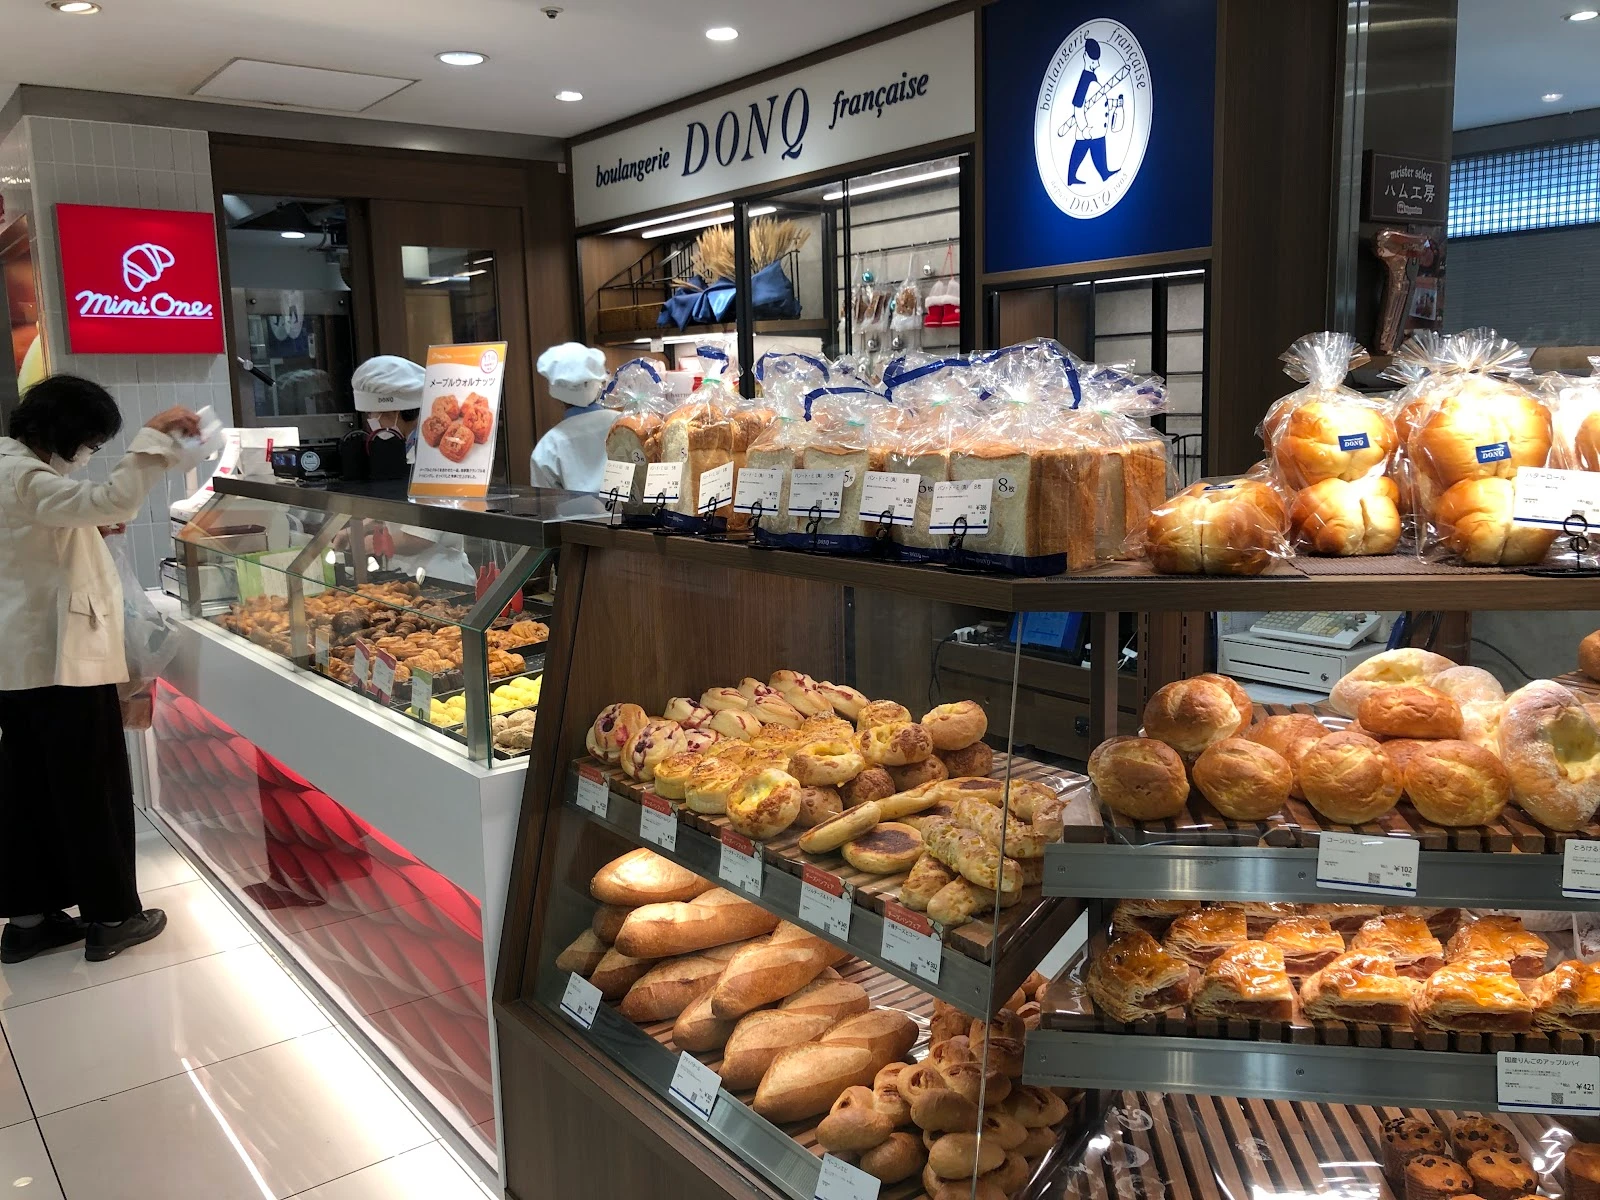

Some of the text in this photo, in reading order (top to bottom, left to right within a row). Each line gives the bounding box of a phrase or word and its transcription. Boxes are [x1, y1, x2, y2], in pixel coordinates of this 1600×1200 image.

[1040, 28, 1146, 111] boulangerie française
[595, 71, 930, 188] boulangerie DONQ française
[1390, 165, 1433, 183] meister select
[1384, 183, 1436, 203] ハム工房
[998, 477, 1015, 493] 8枚
[1393, 864, 1413, 874] ¥102
[1576, 1082, 1595, 1091] ¥421
